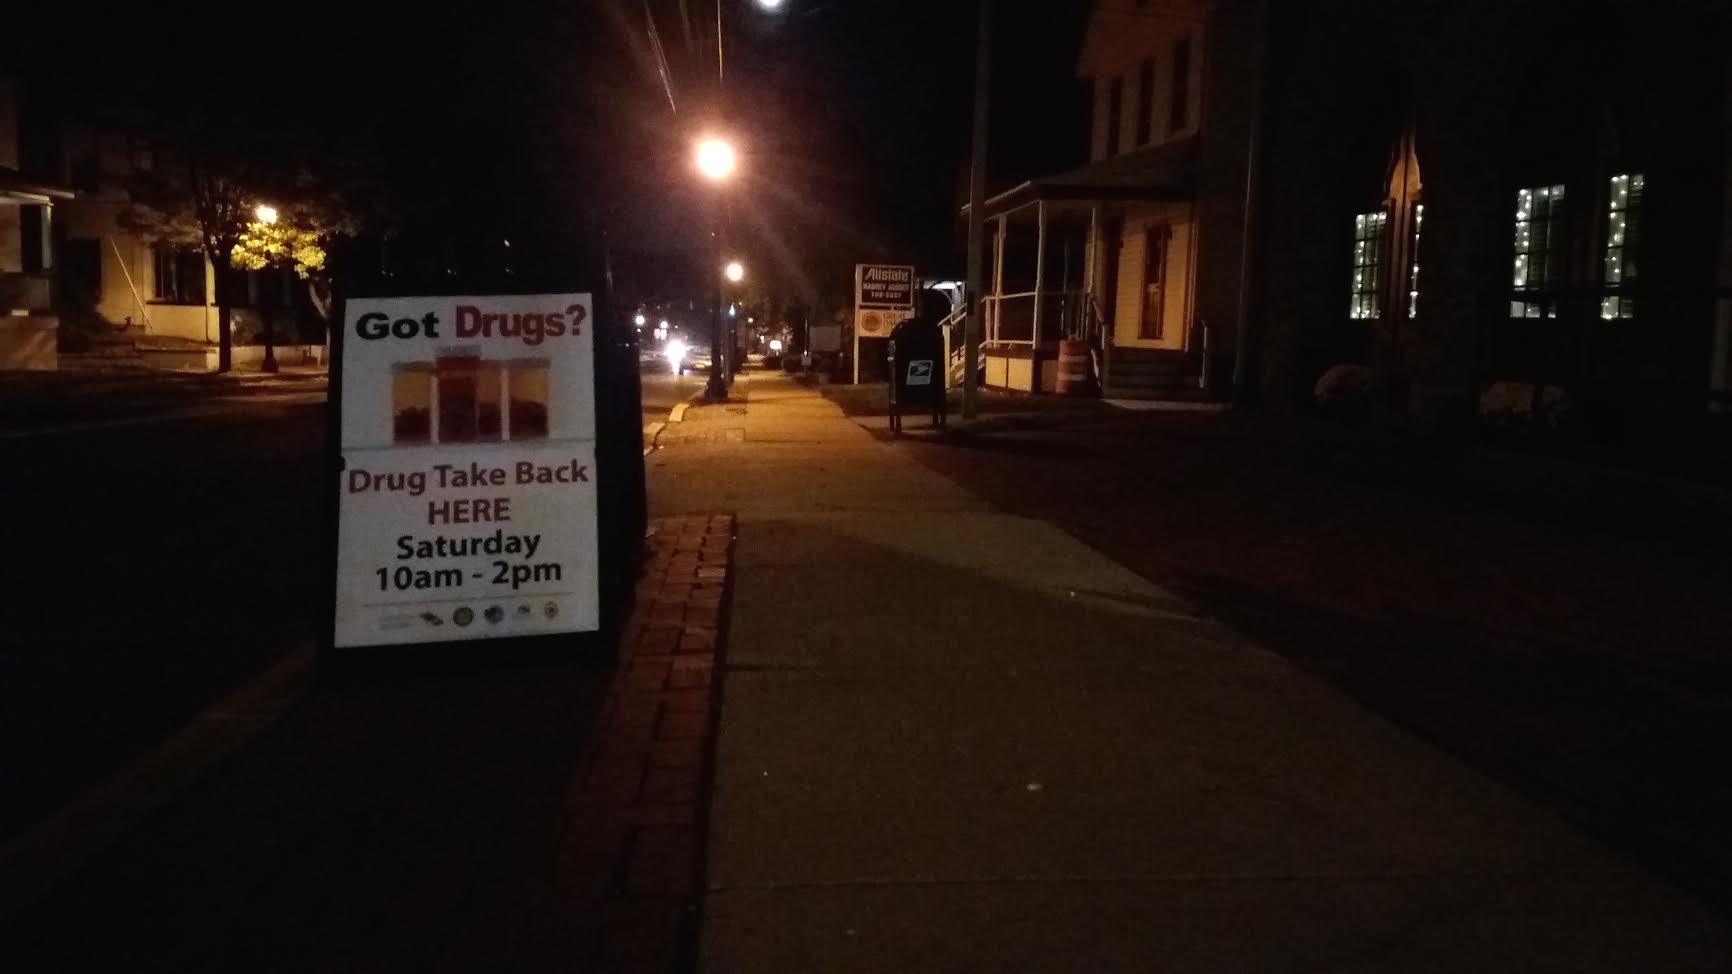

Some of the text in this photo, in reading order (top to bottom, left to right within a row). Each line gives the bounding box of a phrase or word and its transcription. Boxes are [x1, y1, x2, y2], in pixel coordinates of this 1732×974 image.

[865, 267, 909, 281] Allstate
[356, 304, 586, 346] Got Drugs?
[349, 459, 588, 496] Drug Take Back
[428, 498, 511, 525] HERE
[397, 529, 541, 559] Saturday
[376, 566, 462, 591] 10am
[492, 560, 562, 590] 2pm
